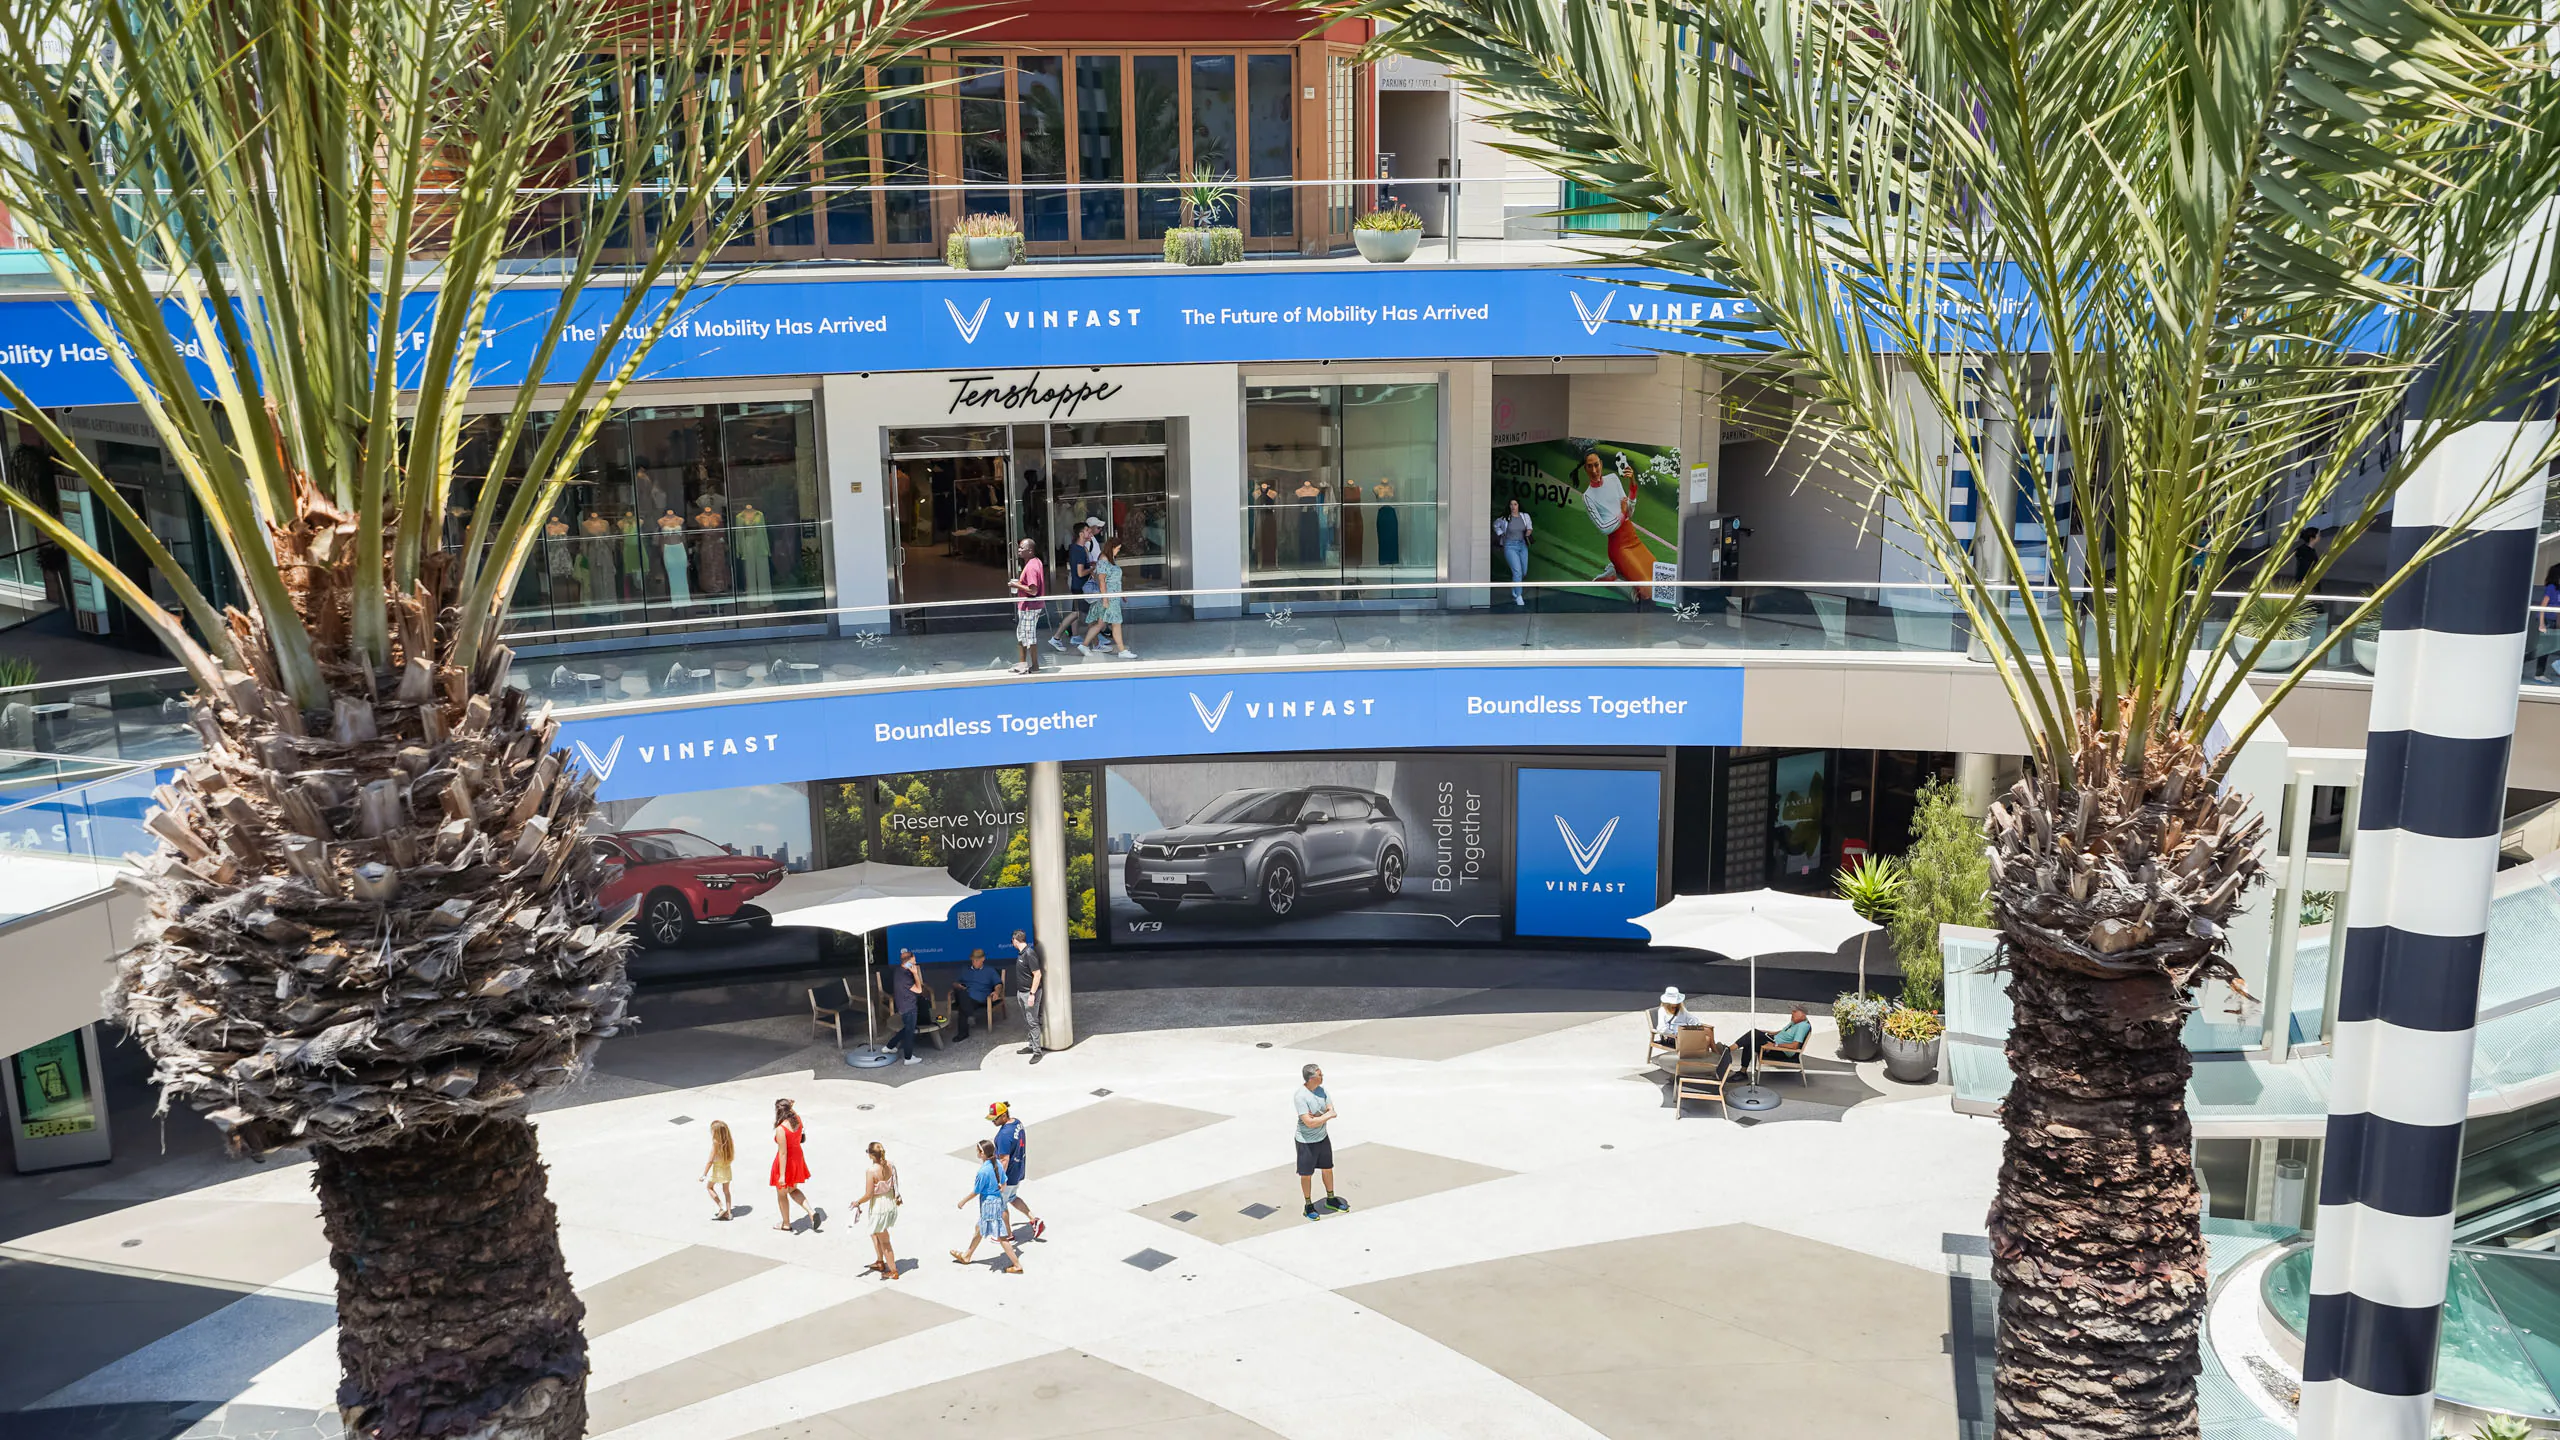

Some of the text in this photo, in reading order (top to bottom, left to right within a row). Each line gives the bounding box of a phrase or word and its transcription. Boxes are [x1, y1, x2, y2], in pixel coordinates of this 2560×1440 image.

[1382, 79, 1407, 88] PARKING
[1005, 309, 1141, 329] VINFAST
[1182, 303, 1489, 325] The Future of Mobility Has Arrived
[1629, 302, 1762, 321] VINFAS
[562, 324, 595, 342] The
[670, 321, 688, 338] of
[695, 317, 770, 339] Mobility
[775, 317, 813, 335] Has
[818, 315, 887, 334] Arrived
[60, 343, 108, 362] Has
[949, 372, 1123, 418] Tenshoppe
[1494, 433, 1520, 444] PARKING
[1512, 477, 1532, 498] to
[1535, 482, 1572, 508] pay.
[1246, 698, 1375, 718] VINFAST
[1467, 694, 1688, 718] Boundless Together
[874, 710, 1098, 743] Boundless Together
[638, 733, 778, 763] VINFAST
[893, 809, 1025, 830] Reserve Yours
[941, 833, 985, 850] Now
[1431, 781, 1454, 892] Boundless
[1459, 790, 1485, 886] Together
[1545, 881, 1626, 893] VINFAST
[1129, 921, 1163, 932] VF9
